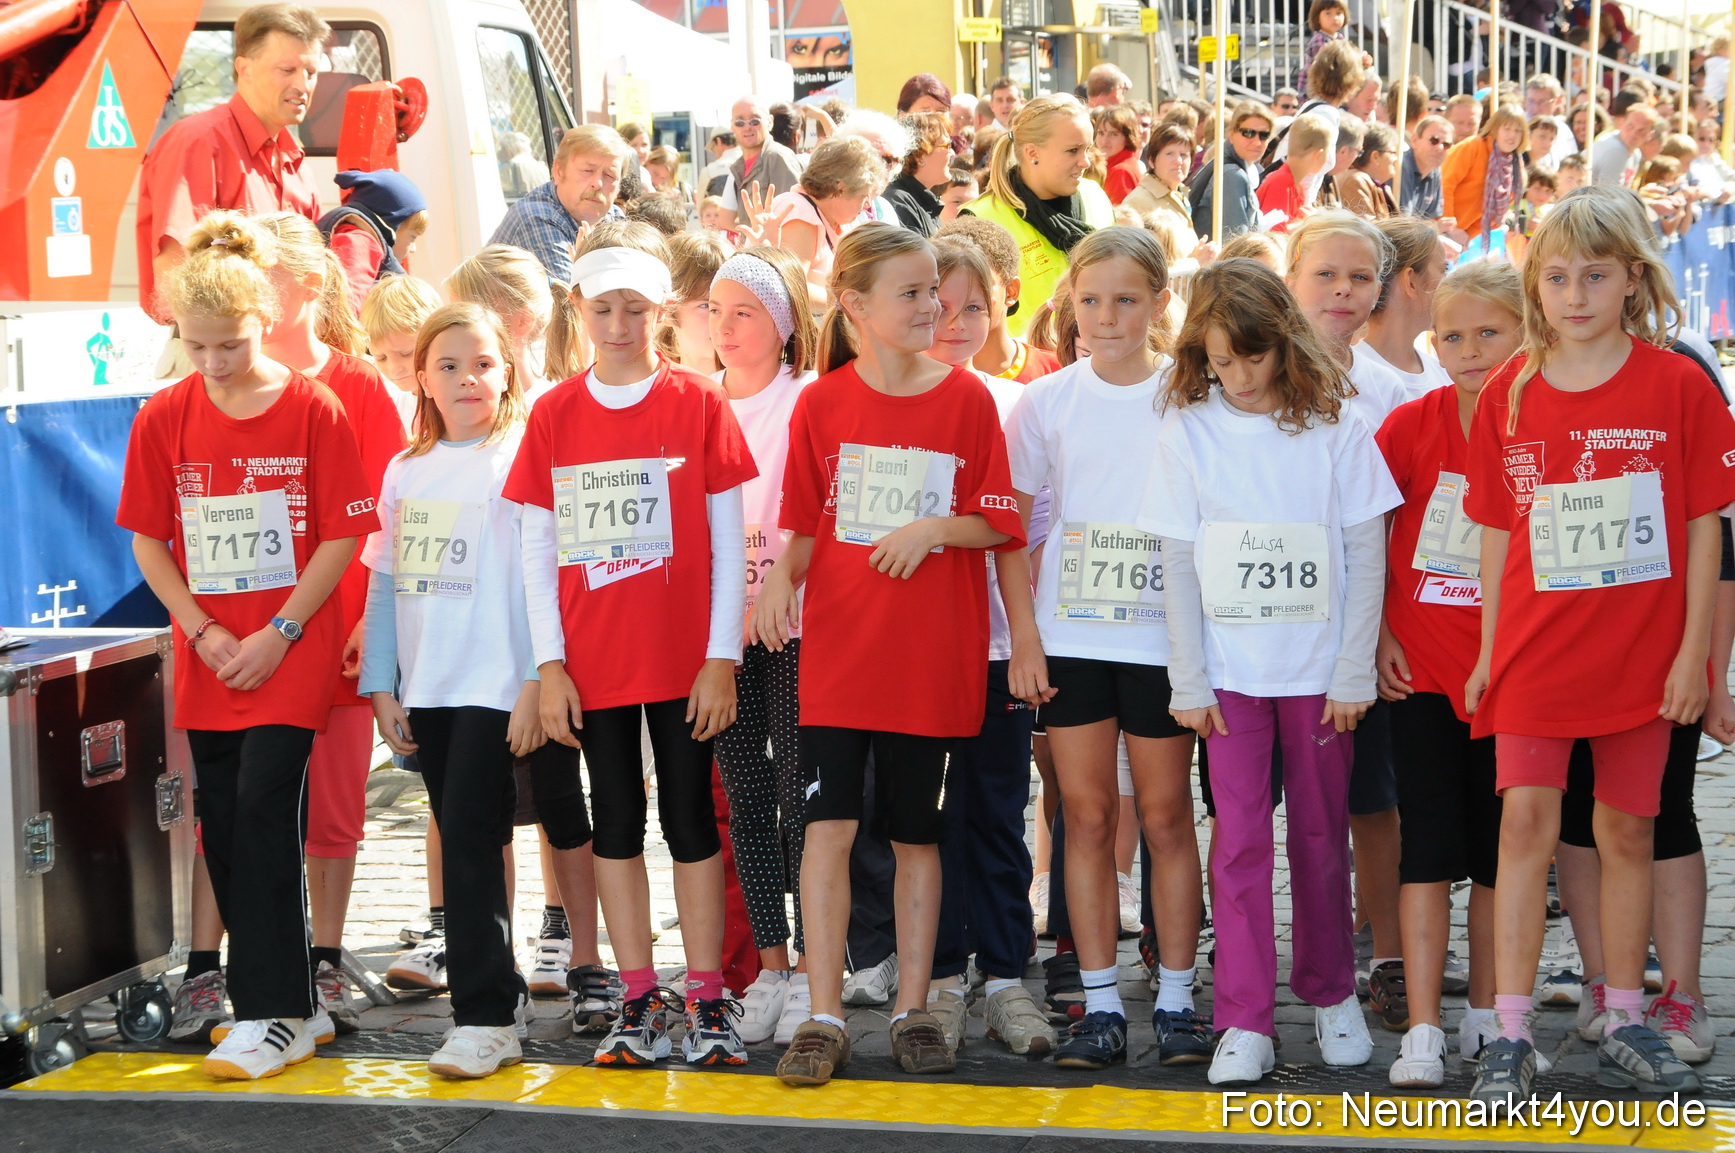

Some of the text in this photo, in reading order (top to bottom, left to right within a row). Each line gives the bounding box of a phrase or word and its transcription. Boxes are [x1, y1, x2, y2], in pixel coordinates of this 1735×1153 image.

[1569, 428, 1667, 442] 11. NEUMARKTER
[1584, 439, 1654, 450] STADTLAUF
[232, 457, 307, 467] 11. NEUMARKTE
[868, 453, 908, 476] Leoni
[1503, 453, 1535, 466] IMMER
[246, 466, 303, 476] STADTLAUF
[867, 485, 940, 517] 7042
[1561, 492, 1604, 512] Anna
[202, 505, 254, 523] Verena
[403, 505, 428, 524] Lisa
[584, 497, 659, 529] 7167
[1566, 515, 1654, 554] 7175
[207, 529, 282, 561] 7173
[403, 536, 467, 565] 7179
[624, 541, 671, 553] PFLEIDERER
[607, 558, 640, 575] DEHN
[746, 558, 775, 585] 62
[1237, 561, 1318, 589] 7318
[1617, 561, 1667, 577] PFLEIDERER
[249, 570, 294, 584] PFLEIDERER
[1091, 561, 1165, 591] 7168
[429, 580, 472, 592] PFLEIDERER
[1441, 586, 1478, 598] DEHN
[1128, 607, 1166, 619] PFLEIDER
[1273, 604, 1315, 613] PFLEIDERER
